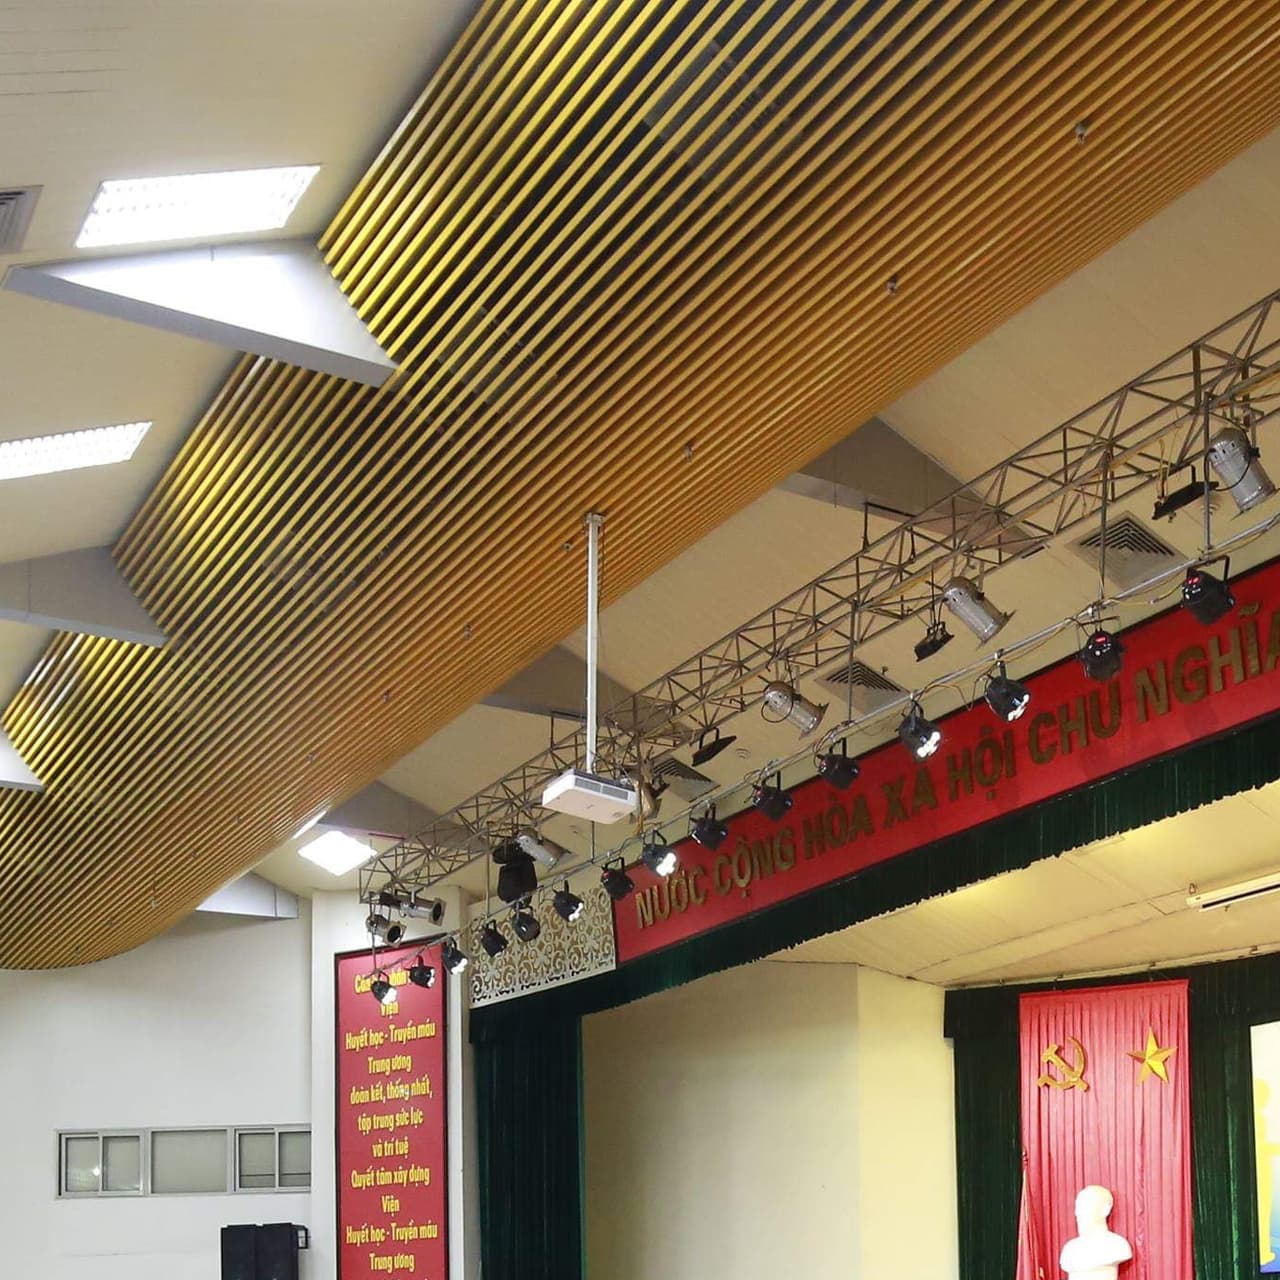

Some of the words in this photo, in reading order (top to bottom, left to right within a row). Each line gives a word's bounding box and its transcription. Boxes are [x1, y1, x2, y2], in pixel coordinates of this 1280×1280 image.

[714, 827, 796, 897] CỘNG
[947, 727, 1017, 799] HỘI
[368, 1056, 391, 1076] Trung
[369, 1252, 393, 1273] Trung
